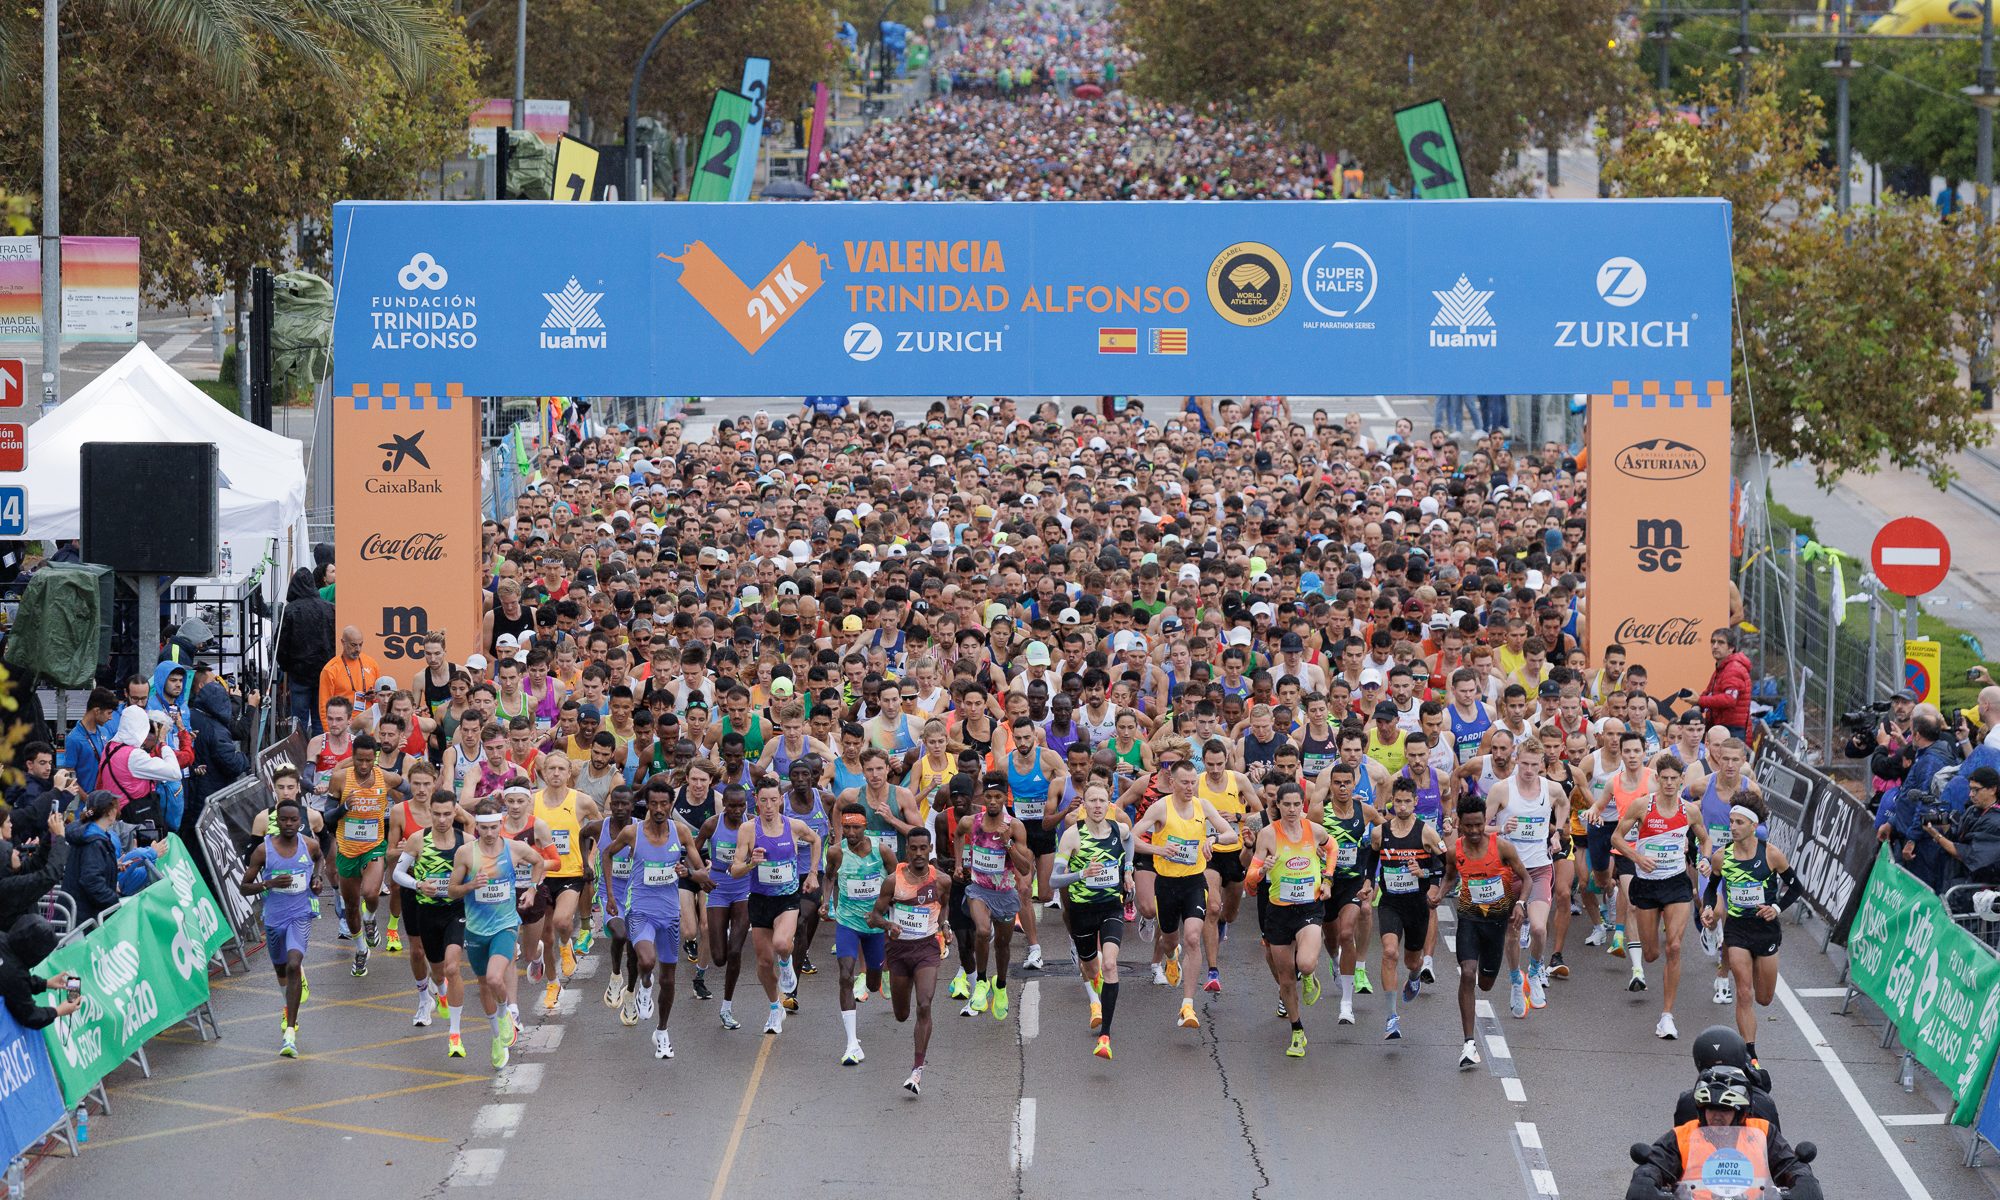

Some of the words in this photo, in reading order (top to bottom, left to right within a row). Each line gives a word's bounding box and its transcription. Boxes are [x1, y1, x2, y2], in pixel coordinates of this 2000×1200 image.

[748, 80, 766, 126] 3
[703, 118, 741, 179] 2
[566, 173, 586, 201] 1
[0, 245, 16, 254] TRA
[19, 244, 32, 254] DE
[844, 240, 1006, 273] VALENCIA
[1212, 259, 1224, 278] GOLD
[1224, 247, 1243, 260] LABEL
[1316, 268, 1365, 279] SUPER
[1316, 280, 1364, 292] HALFS
[372, 294, 476, 308] FUNDACIÓN
[747, 263, 808, 335] 21K
[844, 285, 1010, 312] TRINIDAD
[1020, 284, 1190, 314] ALFONSO
[18, 316, 36, 325] DEL
[371, 312, 477, 330] TRINIDAD
[1247, 314, 1267, 324] ROAD
[1266, 302, 1282, 318] RACE
[372, 332, 477, 350] ALFONSO
[540, 331, 607, 349] luanvi
[896, 331, 1002, 352] ZURICH
[1430, 330, 1496, 347] luanvi
[1554, 321, 1688, 348] ZURICH
[0, 440, 22, 449] ción
[1622, 456, 1699, 470] ASTURIANA
[364, 478, 442, 494] CaixaBank
[360, 532, 448, 561] Coca-Cola
[1614, 617, 1703, 646] Coca-Cola
